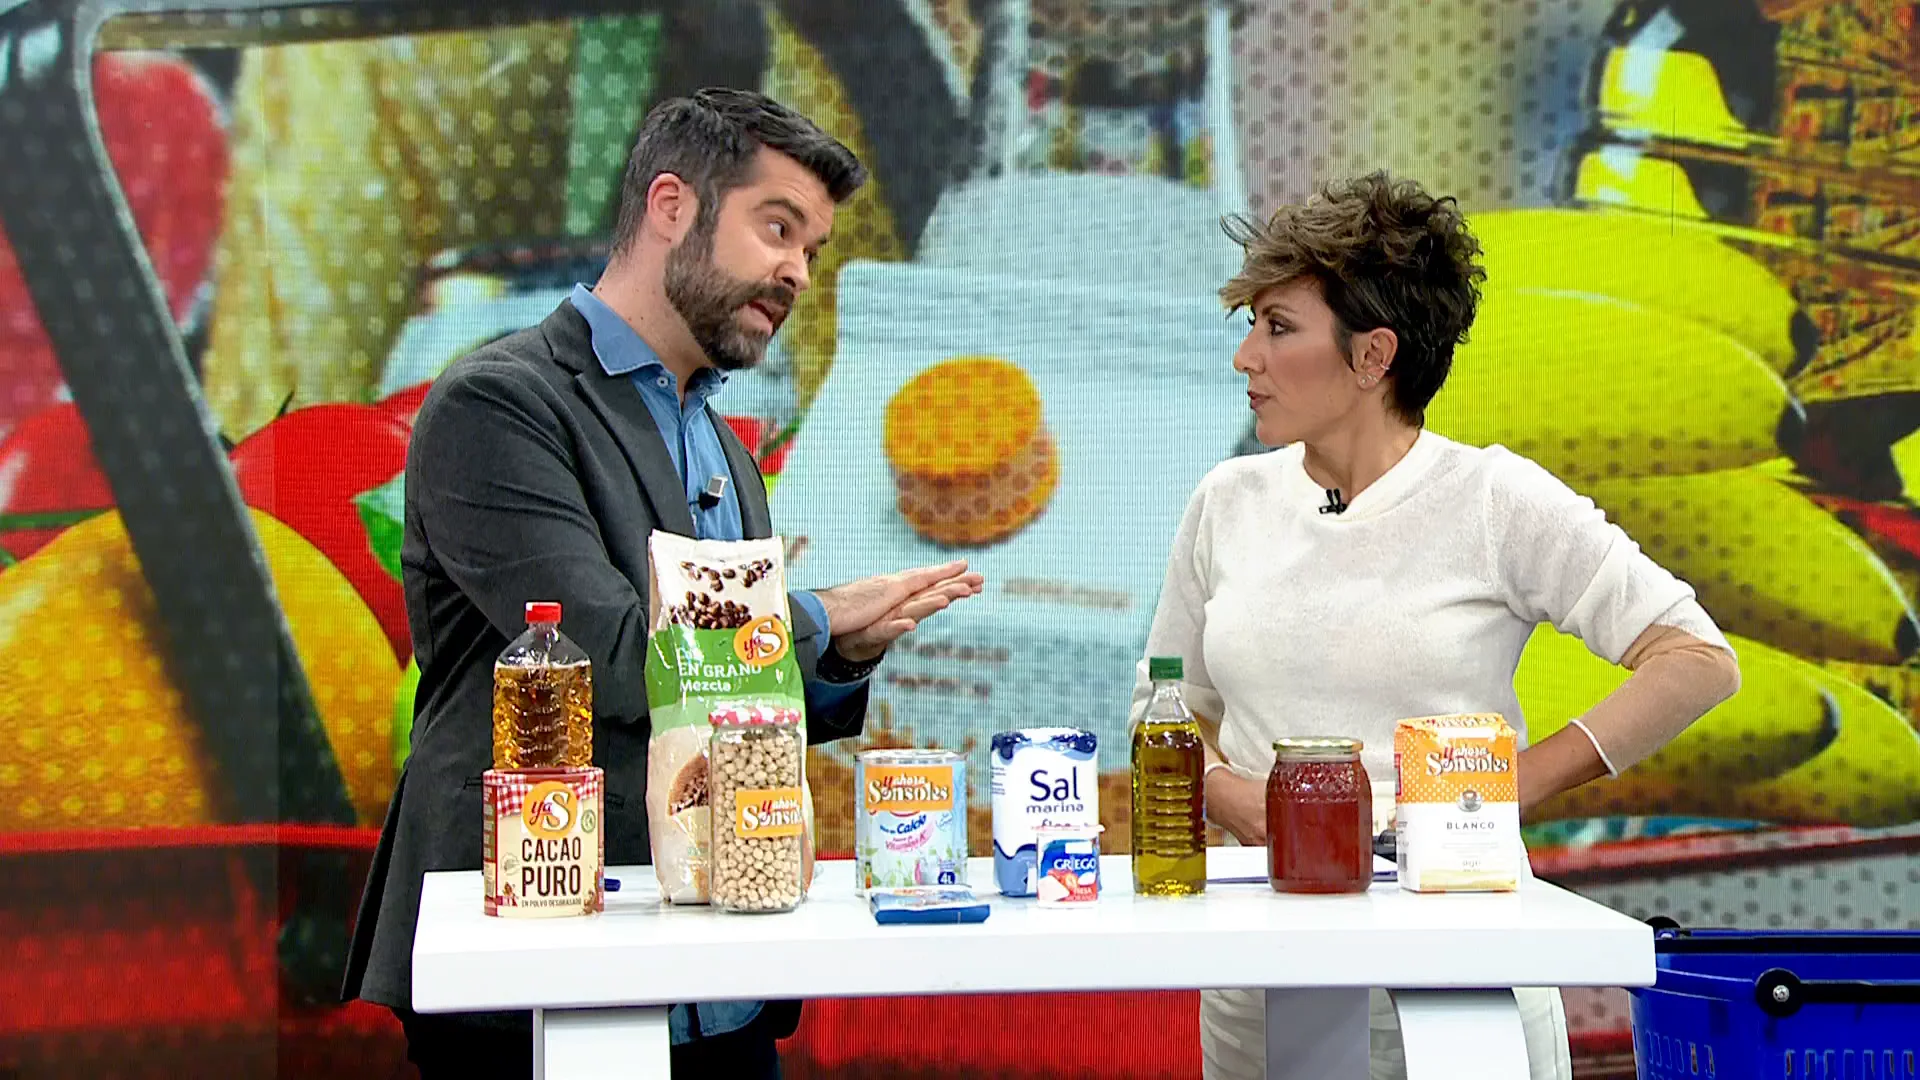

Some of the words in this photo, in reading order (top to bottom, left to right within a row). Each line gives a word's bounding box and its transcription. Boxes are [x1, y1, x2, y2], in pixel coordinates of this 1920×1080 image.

[680, 679, 731, 692] Mezcla
[1425, 752, 1509, 776] Sonsoles
[868, 779, 949, 804] Sonsoles
[1030, 766, 1081, 802] Sal
[1026, 801, 1084, 814] marina
[1446, 821, 1495, 830] BLANCO
[521, 836, 582, 863] CACAO
[1053, 855, 1097, 871] GRIEGO
[521, 864, 582, 897] PURO
